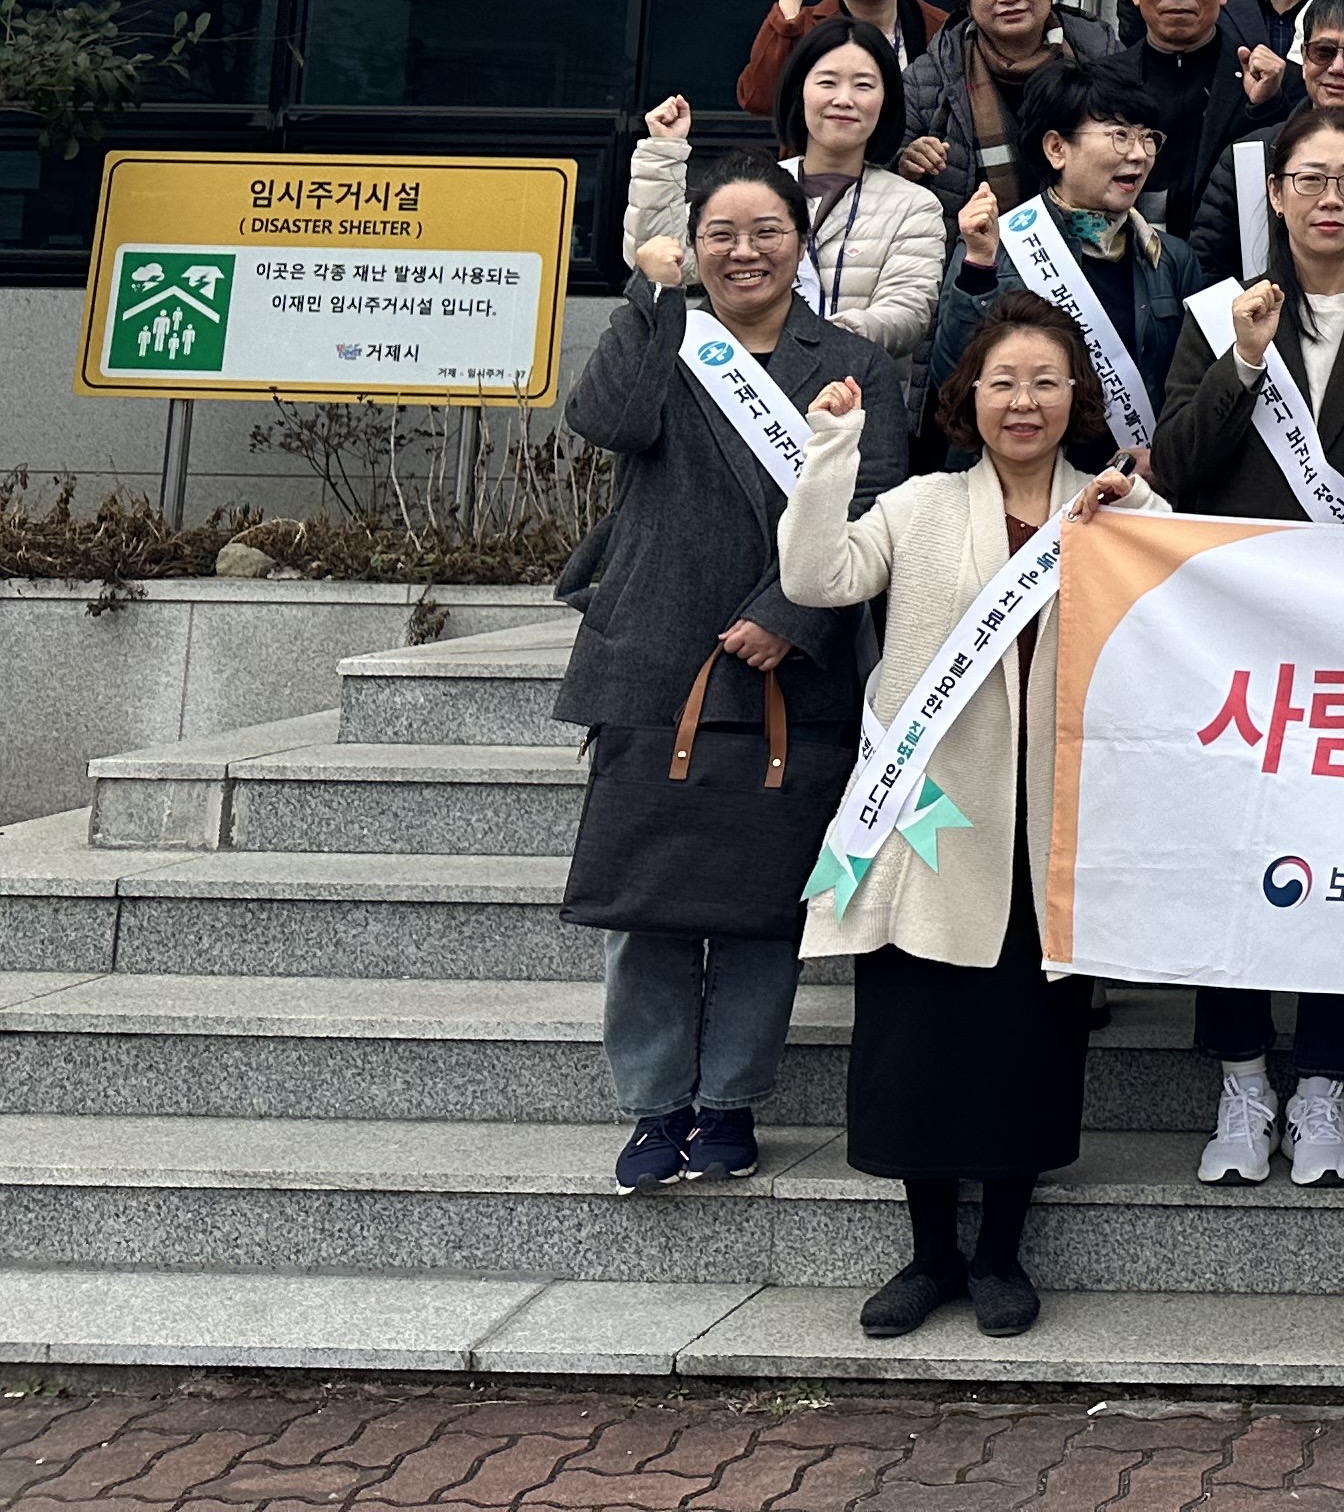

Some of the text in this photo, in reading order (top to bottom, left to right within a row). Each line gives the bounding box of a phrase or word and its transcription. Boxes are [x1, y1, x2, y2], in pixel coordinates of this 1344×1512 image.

[250, 179, 420, 212] 임시주거시설
[251, 218, 333, 235] DISASTER
[338, 219, 411, 236] SHELTER
[256, 262, 521, 286] 이곳은 각종 재난 발생시 사용되는
[272, 294, 498, 317] 이재민 임시주거시설 입니다.
[366, 344, 420, 363] 거제시
[1021, 232, 1060, 282] 거제시
[1087, 339, 1151, 449] 정신건강복지
[721, 367, 771, 420] 거제시
[1259, 373, 1293, 424] 제시
[1285, 425, 1318, 485] 보건소
[973, 589, 1023, 652] 치료가
[920, 651, 973, 719] 필요한
[859, 720, 926, 830] 질병입니다
